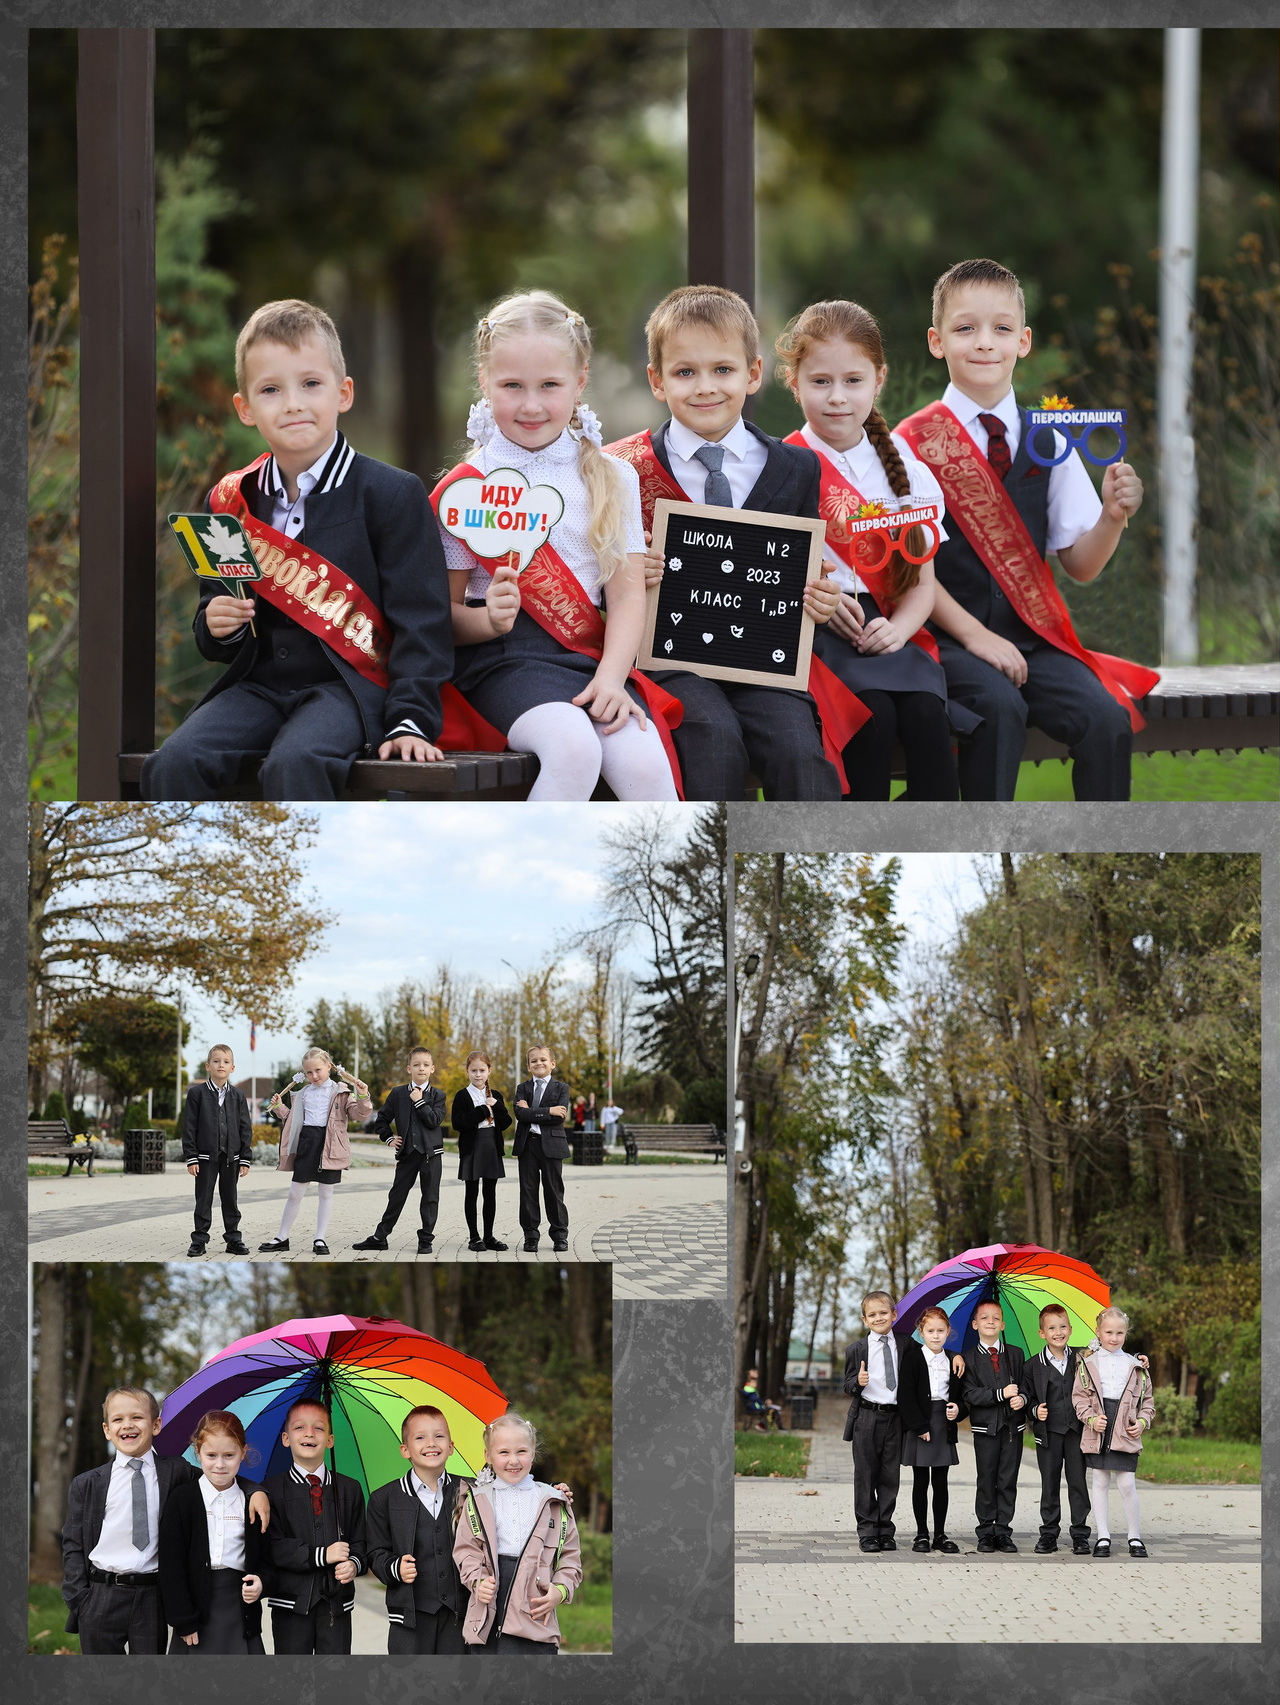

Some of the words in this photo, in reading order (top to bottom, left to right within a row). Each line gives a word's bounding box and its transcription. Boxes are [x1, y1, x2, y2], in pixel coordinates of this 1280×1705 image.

[1031, 411, 1123, 425] ПЕРВОКЛАШКА
[480, 484, 524, 508] ИДУ
[446, 507, 459, 526] В
[464, 508, 548, 532] ШКОЛУ!
[851, 508, 935, 533] ПЕРВОКЛАШКА
[171, 516, 221, 577] 1
[683, 530, 734, 550] ШКОЛА
[766, 541, 775, 556] N
[780, 543, 790, 558] 2
[217, 564, 255, 577] КЛАСС
[746, 567, 781, 585] 2023
[690, 589, 742, 609] КЛАСС
